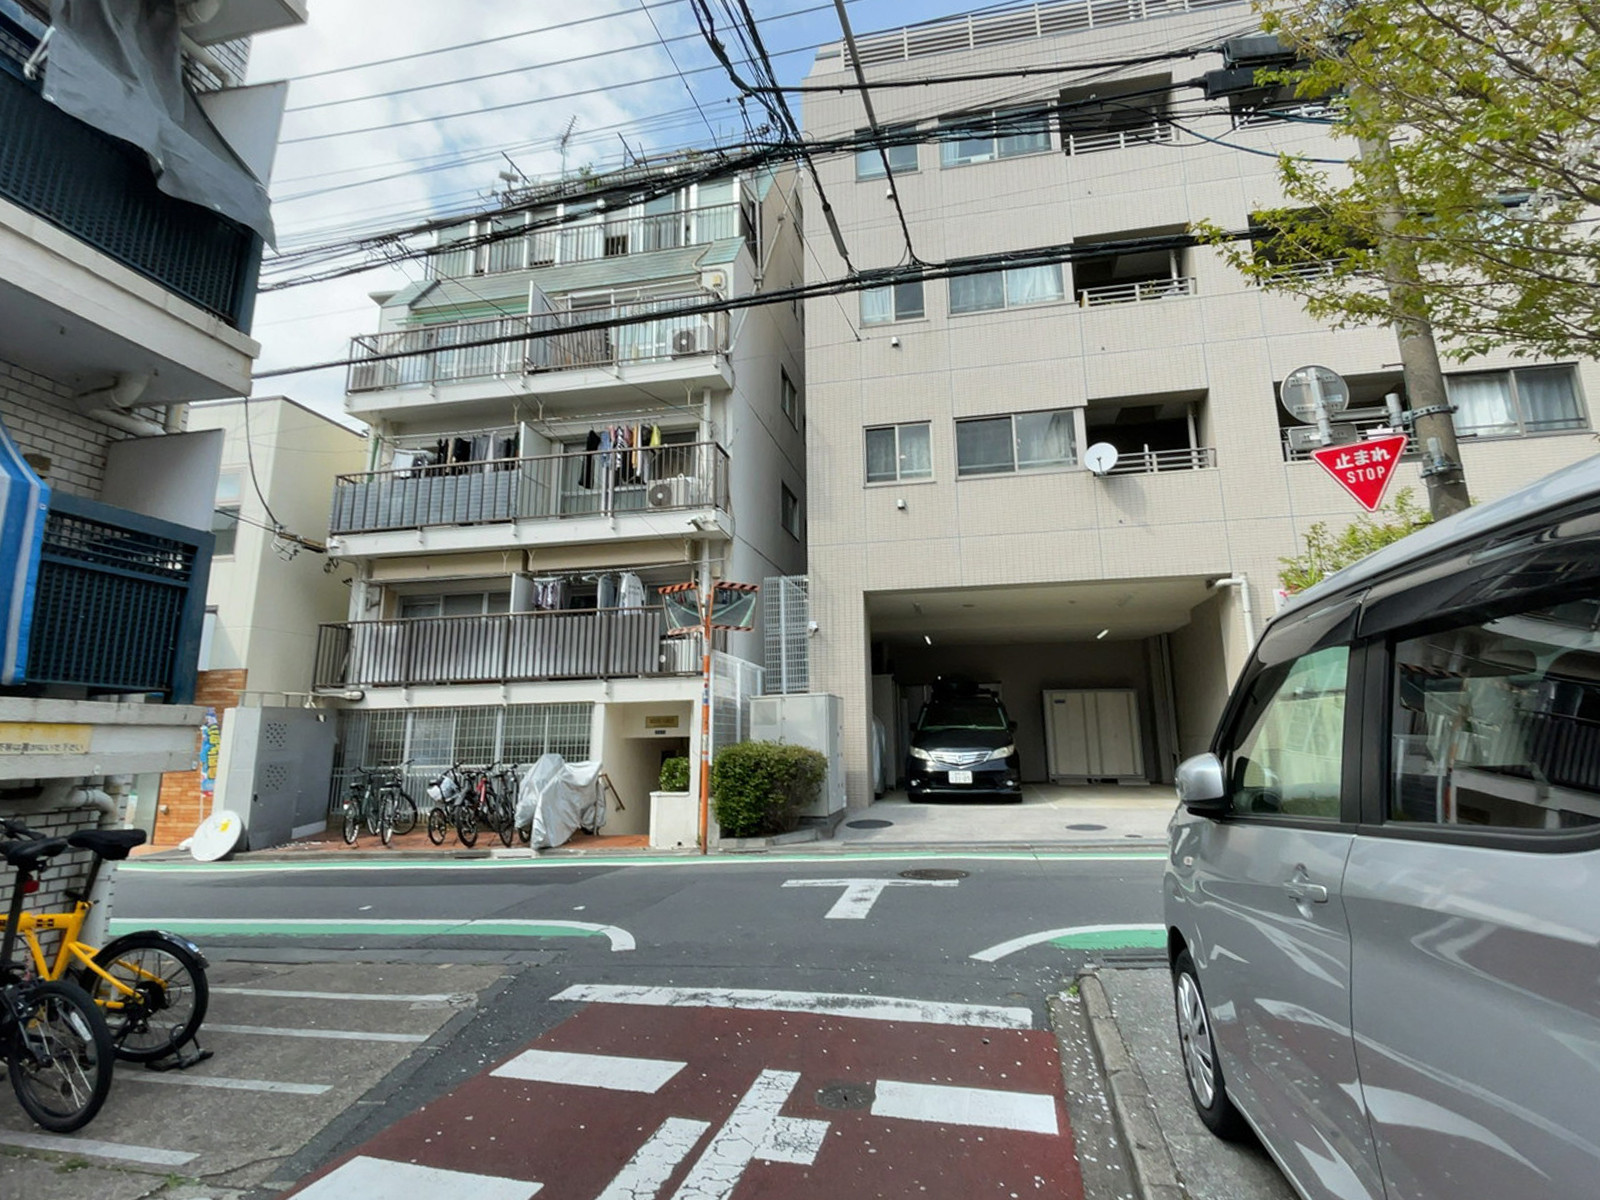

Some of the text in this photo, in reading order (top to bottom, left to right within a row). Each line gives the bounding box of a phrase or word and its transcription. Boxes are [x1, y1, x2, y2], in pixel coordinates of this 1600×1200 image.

[1335, 447, 1391, 469] 止まれ
[1346, 466, 1386, 484] STOP
